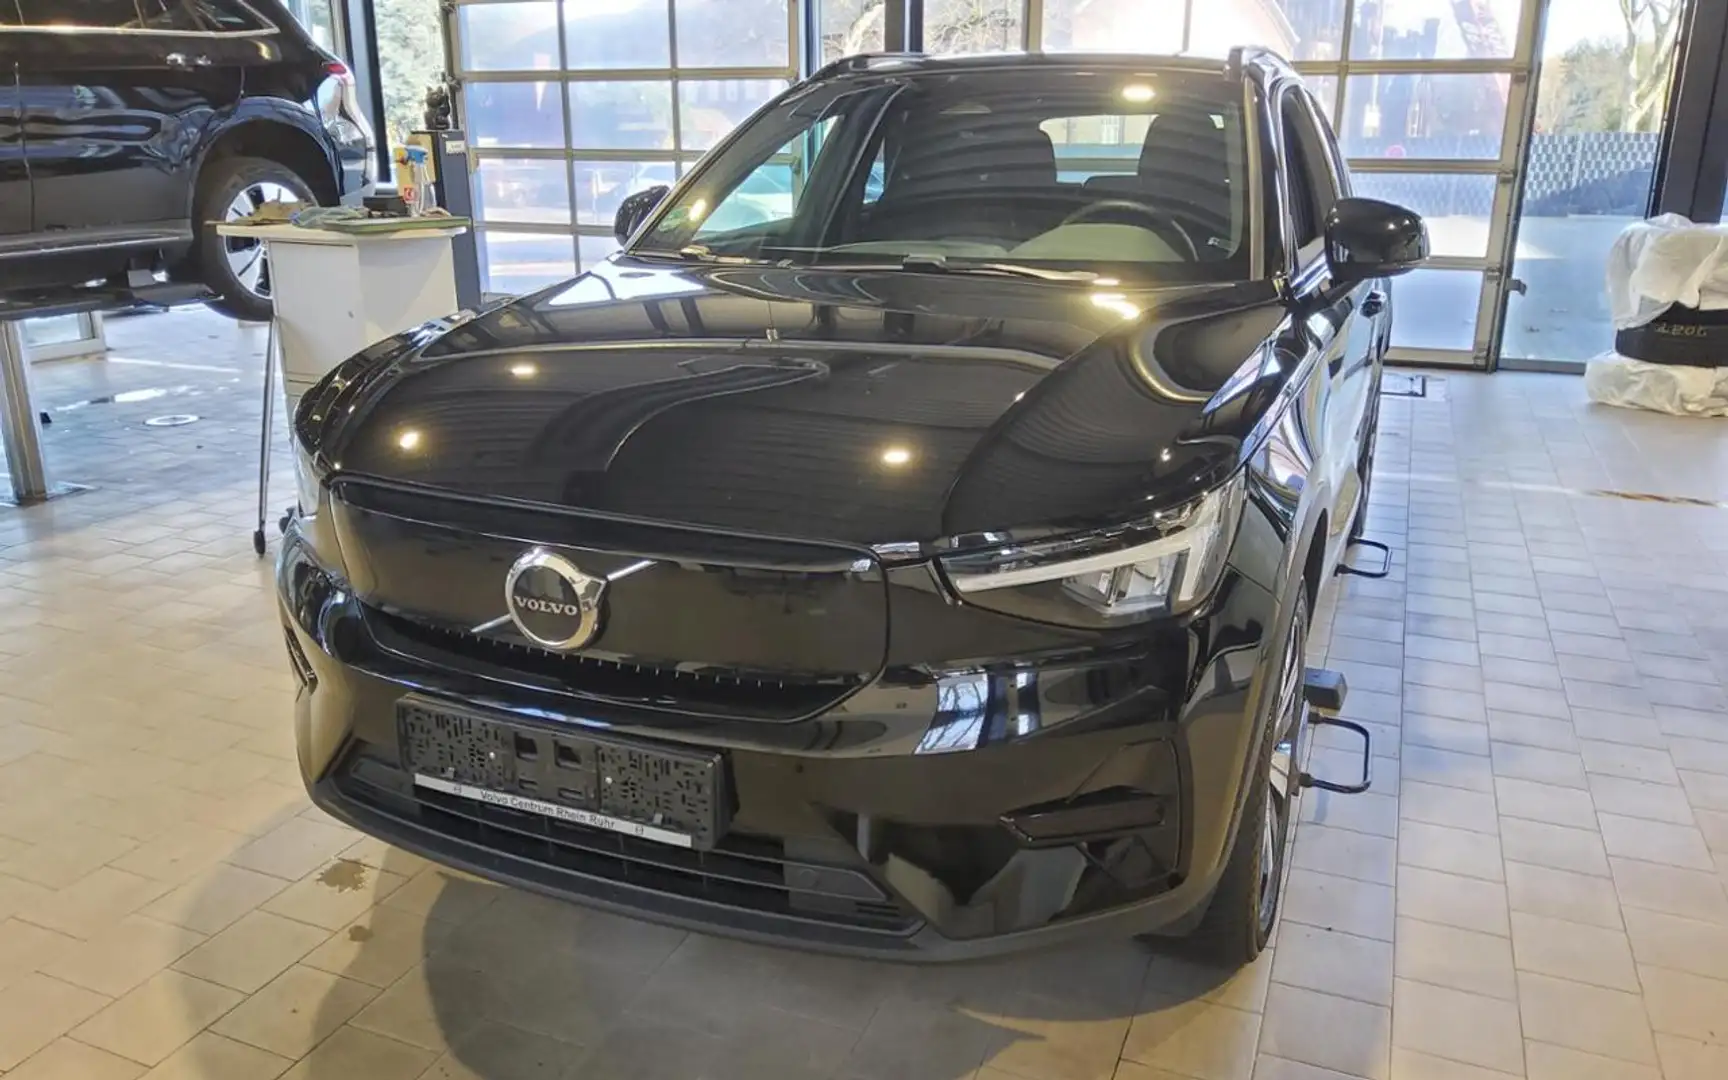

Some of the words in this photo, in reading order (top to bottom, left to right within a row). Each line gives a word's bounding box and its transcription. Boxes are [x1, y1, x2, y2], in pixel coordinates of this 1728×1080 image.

[513, 595, 578, 616] VOLVO
[480, 790, 508, 805] Volvo
[510, 797, 554, 815] Centrum
[556, 807, 586, 821] Rhein
[589, 815, 615, 829] Ruhr
